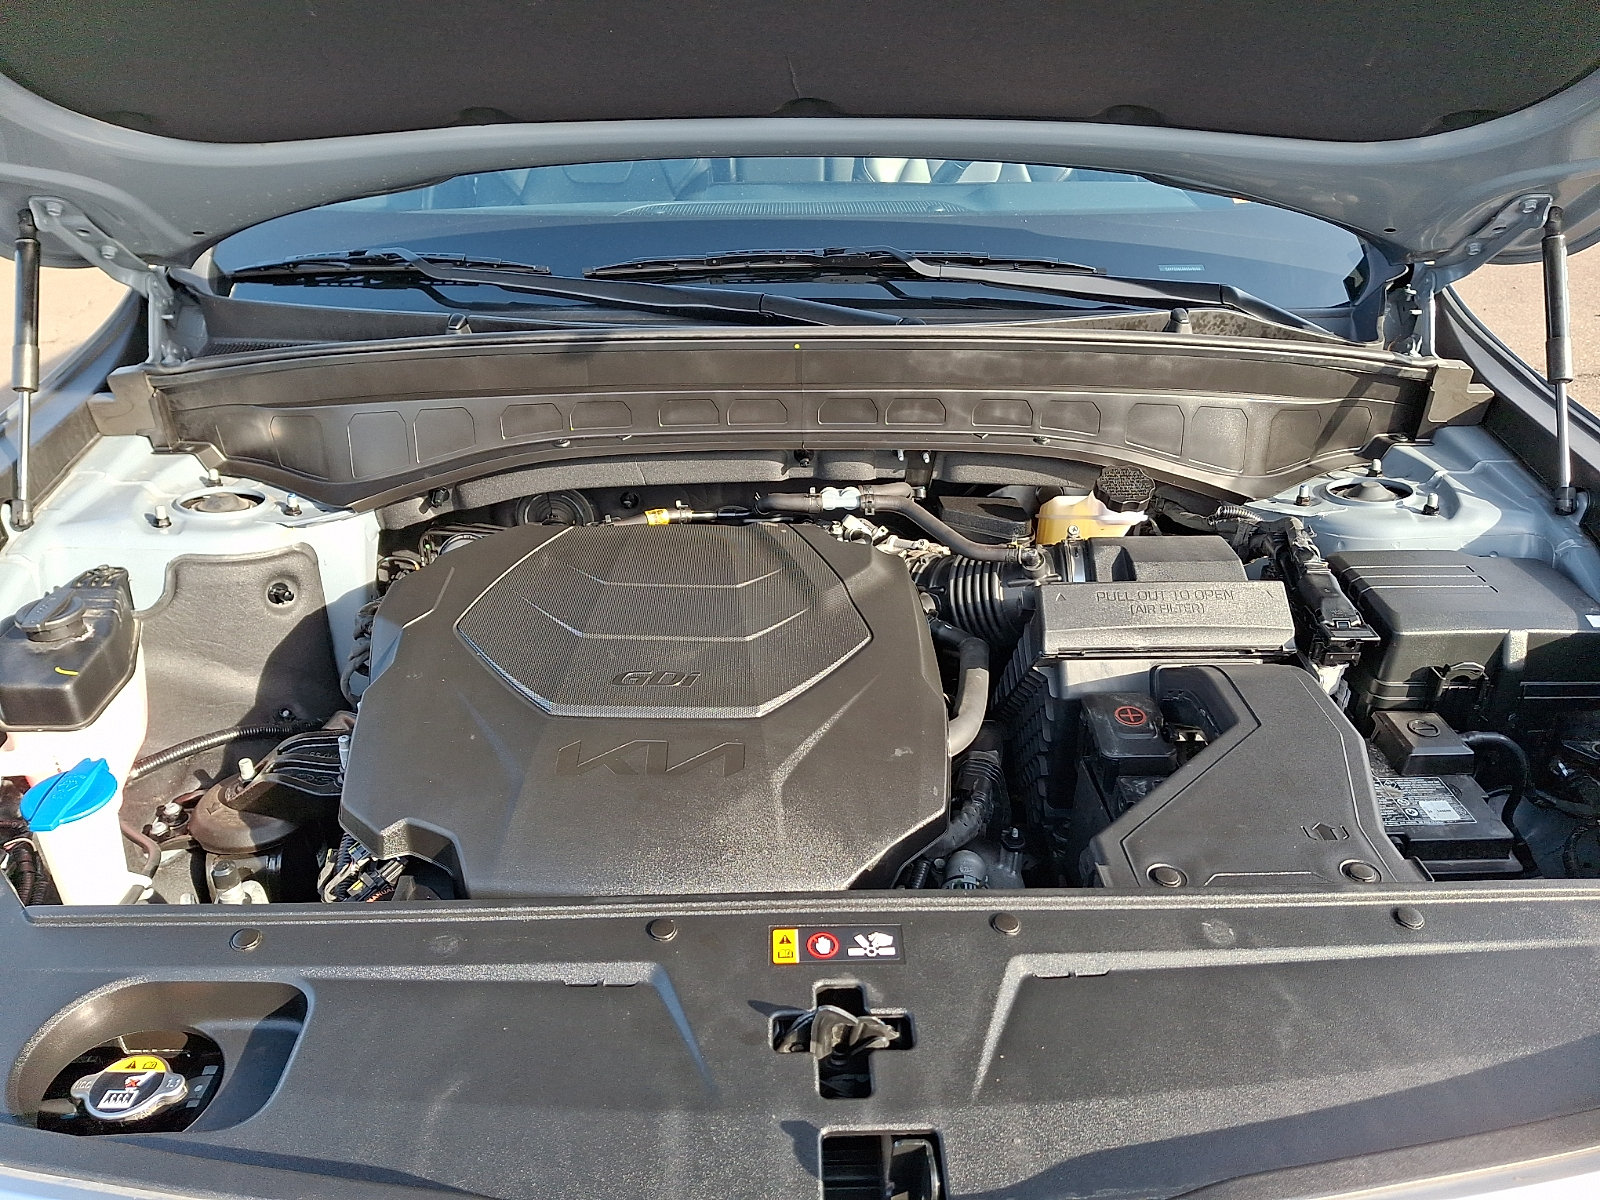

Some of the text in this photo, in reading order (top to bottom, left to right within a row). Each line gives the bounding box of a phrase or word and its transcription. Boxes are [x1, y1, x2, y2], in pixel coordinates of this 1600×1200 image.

[1096, 589, 1234, 602] PULL OUT TO OPEN
